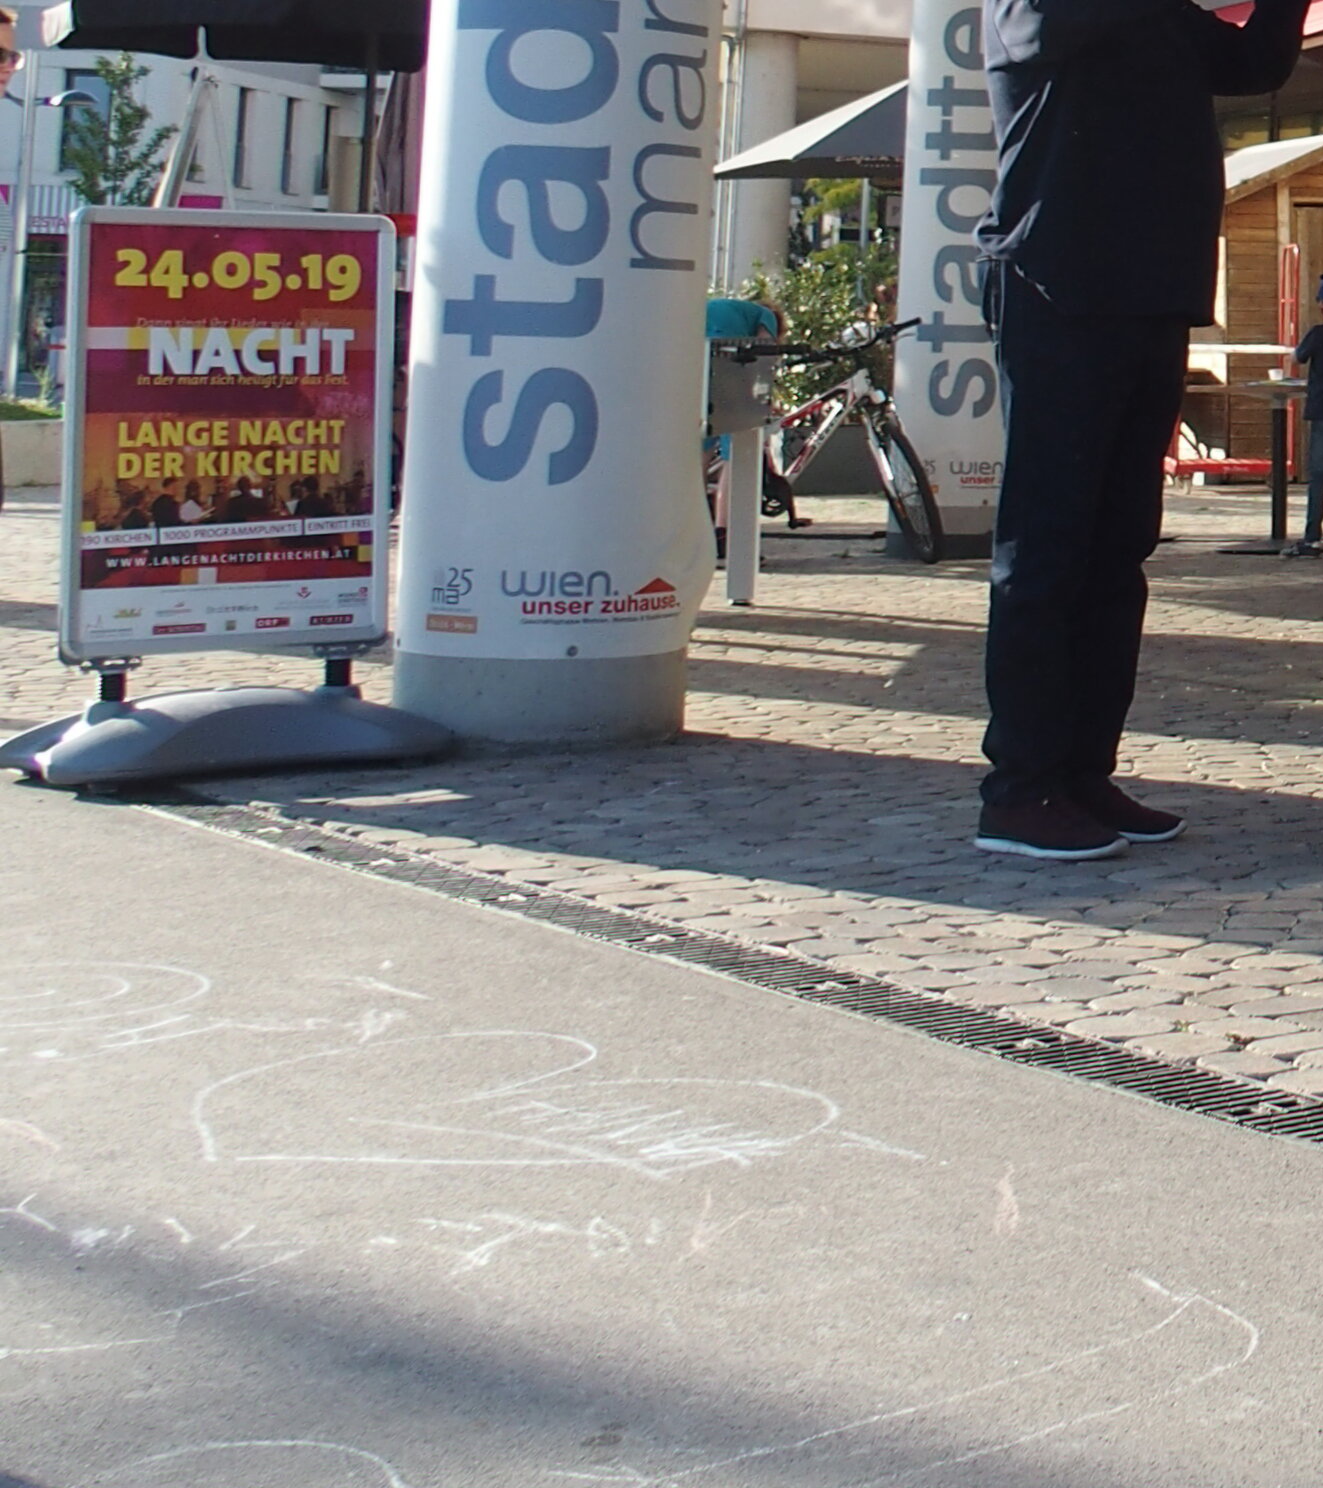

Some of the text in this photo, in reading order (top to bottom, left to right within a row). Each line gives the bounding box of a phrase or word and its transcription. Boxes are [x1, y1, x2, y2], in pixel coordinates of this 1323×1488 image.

[115, 248, 362, 302] 24.05.19
[148, 327, 355, 376] NACHT
[117, 419, 345, 448] LANGE NACHT
[116, 449, 341, 480] DER KIRCHEN
[104, 532, 153, 544] KIRCHEN
[193, 522, 299, 539] PROGRAMMPUNKTE
[307, 519, 348, 531] EINTRITT
[105, 548, 351, 568] WWW.LANGENACHTDERKIRCHEN.AT
[447, 567, 475, 597] 25
[521, 594, 681, 615] unser zuhause.
